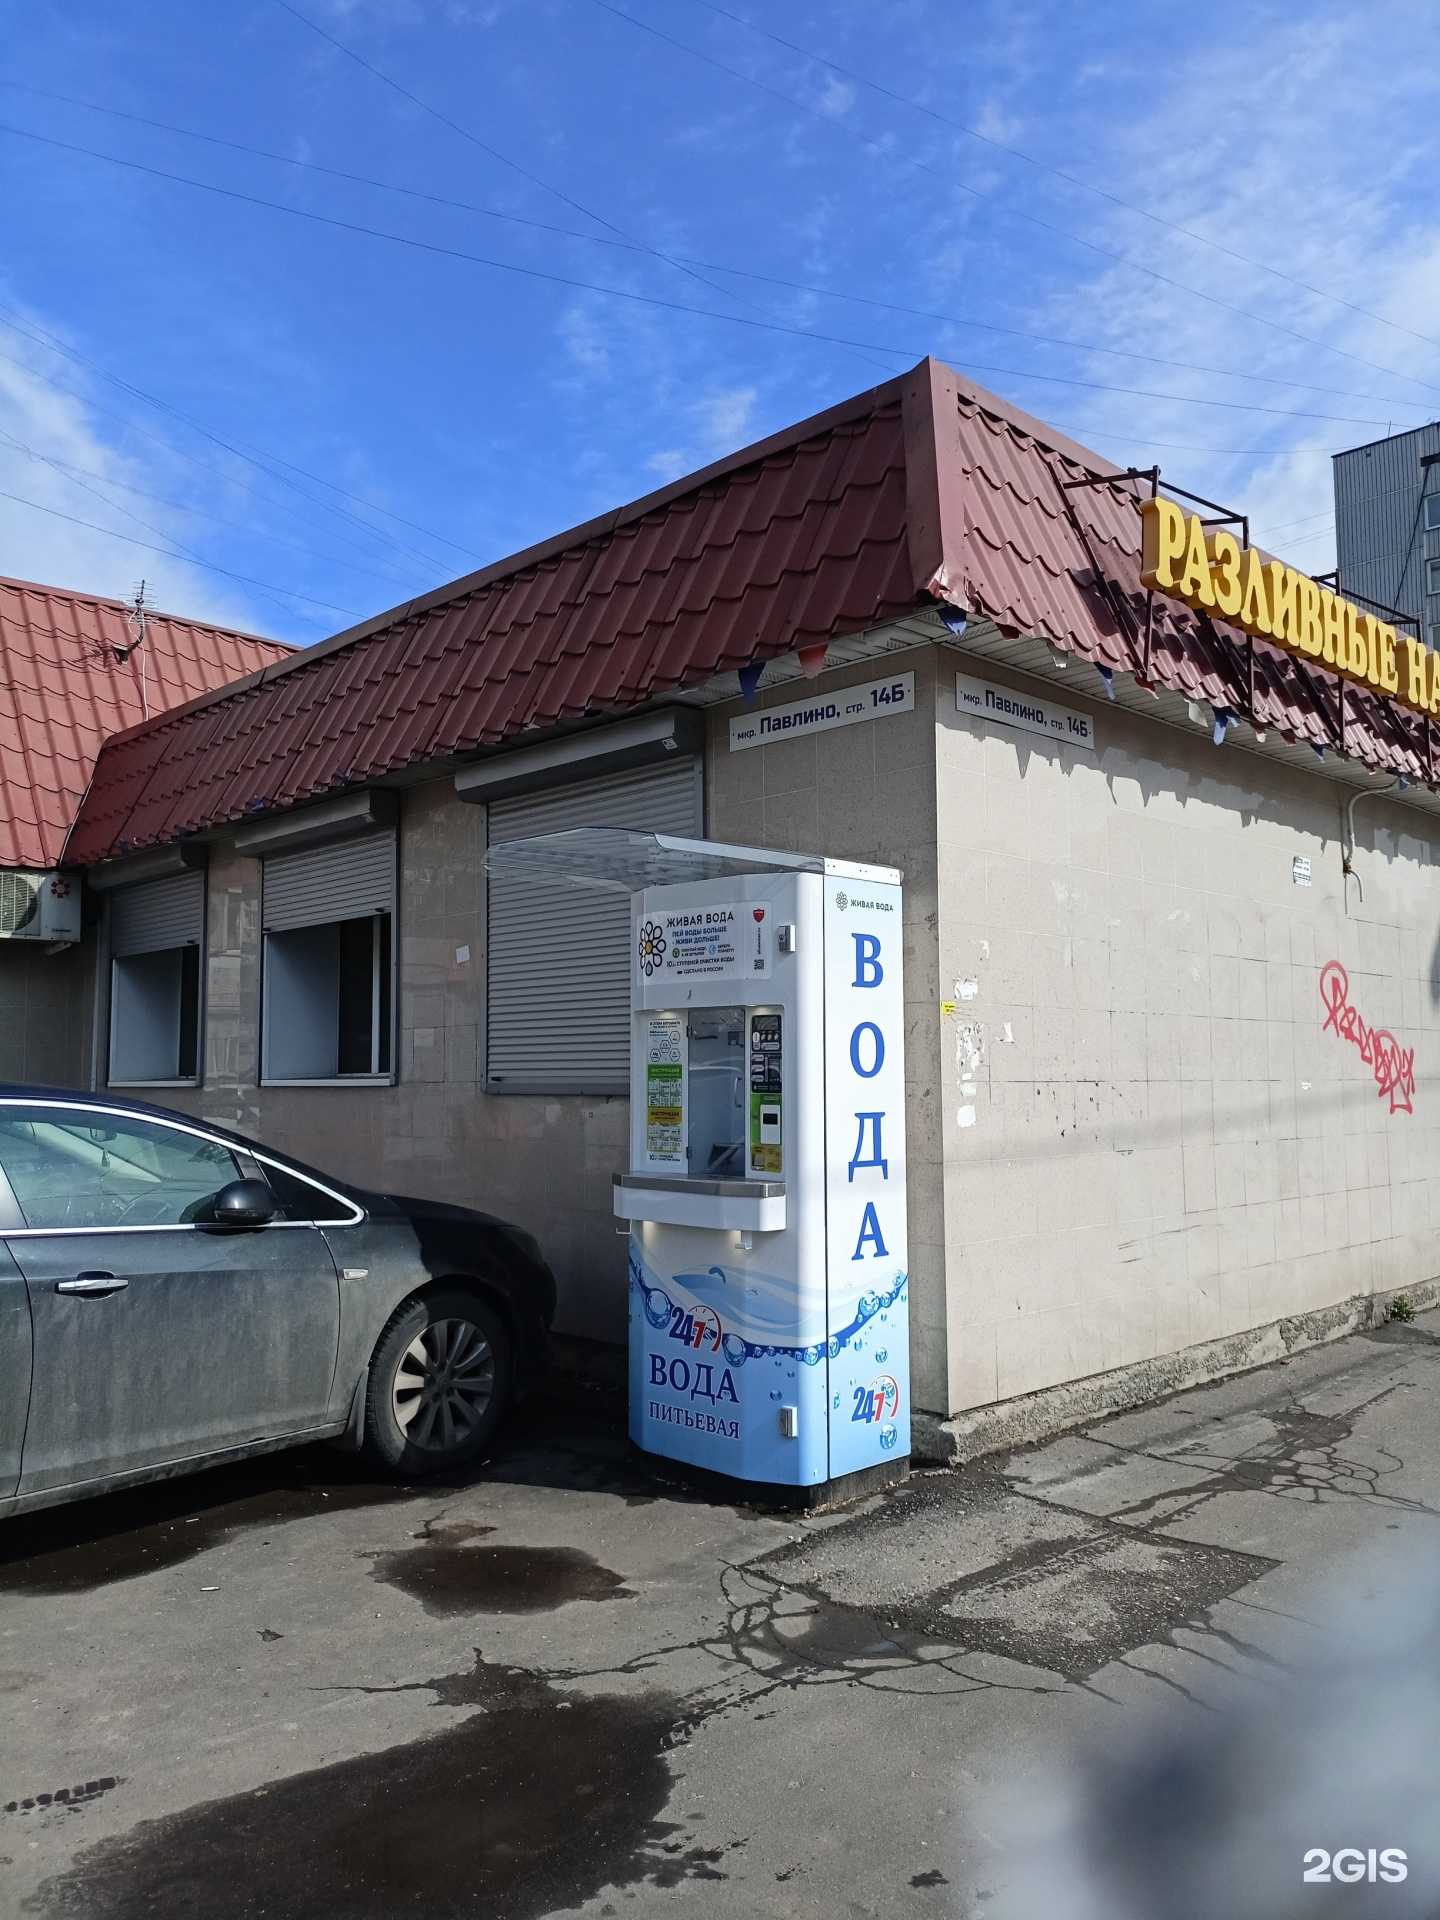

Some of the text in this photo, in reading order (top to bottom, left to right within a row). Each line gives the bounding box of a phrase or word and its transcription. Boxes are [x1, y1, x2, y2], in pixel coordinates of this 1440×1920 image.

[1152, 496, 1398, 695] РАЗЛИВНЫЕ
[737, 683, 905, 741] мкр. Павлино, стр. 14Б
[963, 689, 1089, 738] мкр. Павлино, стр. 14Б
[667, 912, 734, 928] ЖИВАЯ ВОДА
[850, 899, 894, 913] ЖИВАЯ ВОДА
[684, 928, 702, 937] ВОДЫ
[702, 926, 727, 935] БОЛЬШЕ
[847, 932, 889, 1261] ВОДА
[649, 1354, 740, 1406] ВОДА
[649, 1401, 740, 1440] ПИТЬЕВАЯ
